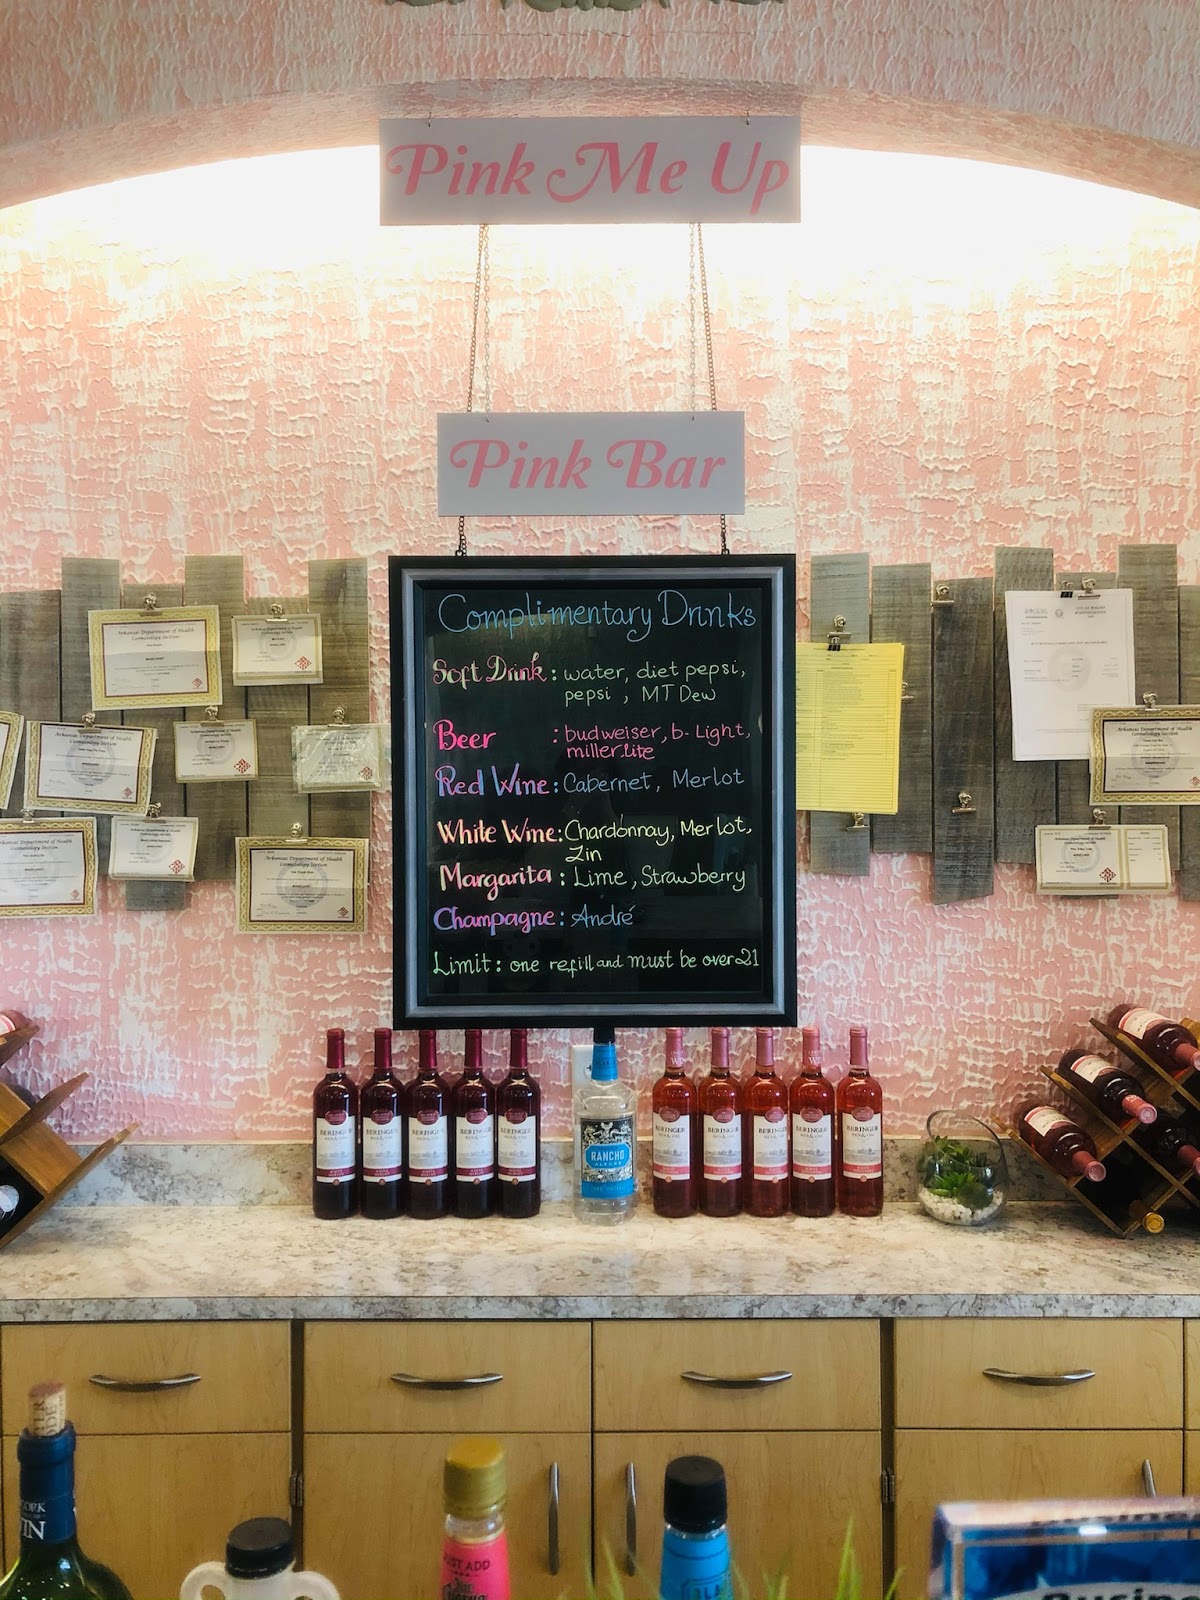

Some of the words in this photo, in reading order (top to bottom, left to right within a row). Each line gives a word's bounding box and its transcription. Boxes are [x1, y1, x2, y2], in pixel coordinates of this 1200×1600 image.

[386, 142, 535, 196] Pink
[547, 141, 688, 203] Me
[711, 142, 789, 214] Up
[449, 439, 595, 489] Pink
[607, 439, 726, 490] Bar
[438, 592, 652, 642] Complimentary
[658, 589, 757, 628] Drinks
[432, 658, 483, 690] Soft
[564, 664, 629, 684] water,
[636, 661, 678, 680] diet
[685, 660, 746, 684] pepsi,
[642, 684, 675, 702] MT
[679, 685, 716, 702] Dew
[433, 719, 497, 751] Beer
[564, 724, 668, 744] budweiser,
[695, 723, 751, 746] Light,
[434, 764, 485, 797] Red
[672, 768, 744, 789] Merlot
[437, 819, 496, 844] White
[680, 816, 753, 838] Merlot,
[565, 845, 602, 863] Zin
[641, 864, 746, 891] Strawberry
[571, 904, 634, 927] André
[509, 958, 539, 973] one
[550, 954, 594, 978] refill
[597, 955, 624, 969] and
[627, 954, 673, 969] must
[680, 950, 697, 968] be
[655, 1125, 686, 1133] BERINGER
[708, 1126, 739, 1134] BERINGER
[796, 1125, 828, 1133] BERINGER
[591, 1150, 625, 1161] RANCHO
[465, 1560, 491, 1571] ADD
